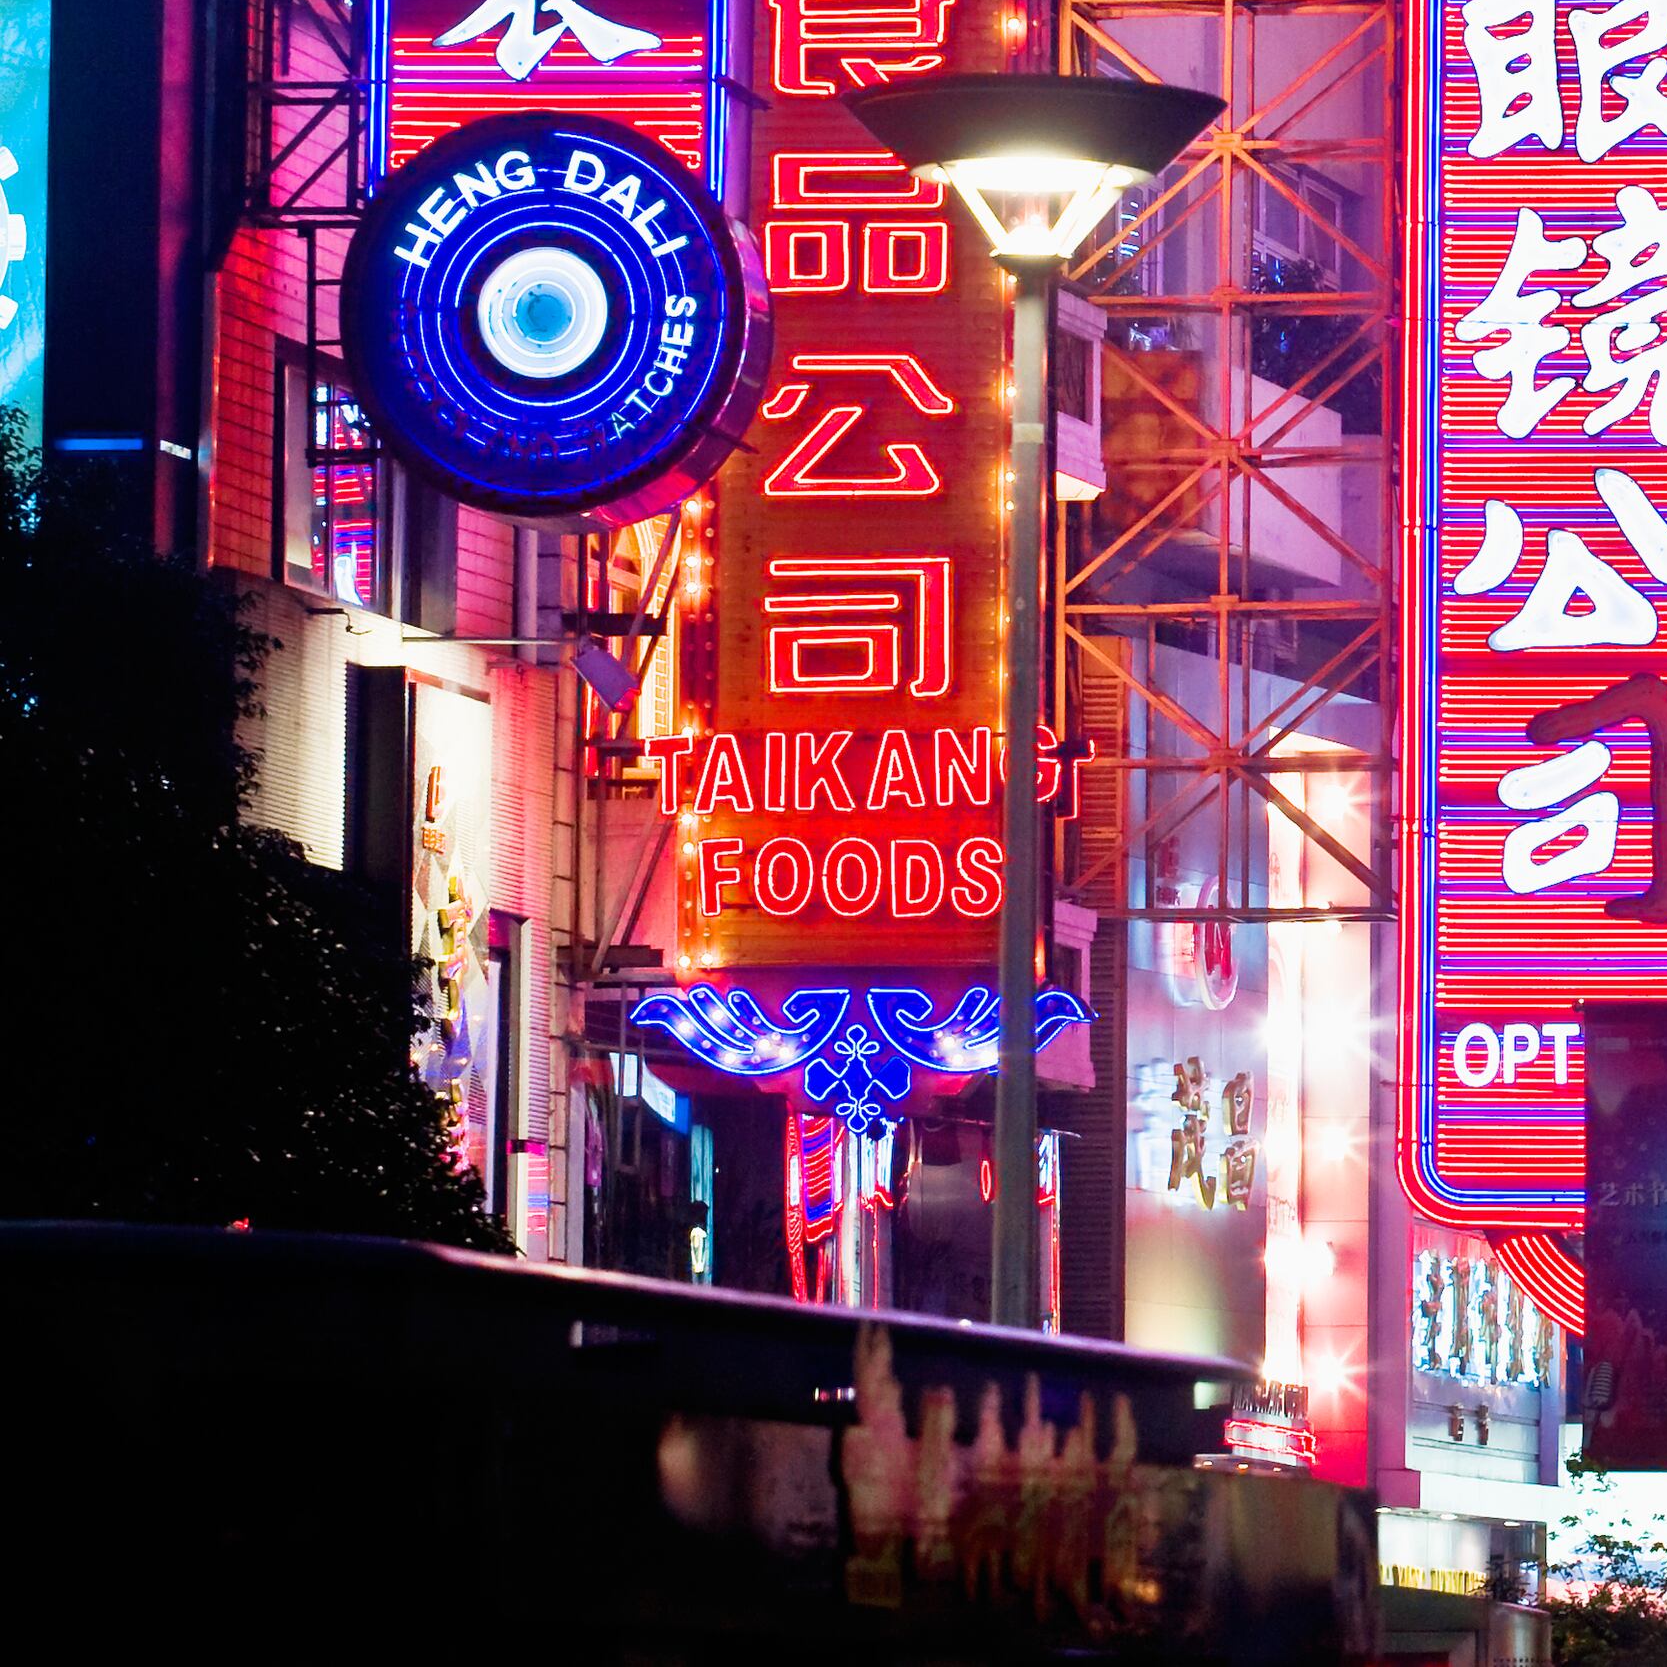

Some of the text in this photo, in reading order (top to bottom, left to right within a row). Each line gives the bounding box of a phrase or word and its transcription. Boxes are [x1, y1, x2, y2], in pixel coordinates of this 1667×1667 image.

[394, 150, 690, 269] HENG DALI
[606, 294, 698, 440] ATCHES
[698, 835, 1005, 919] FOODS
